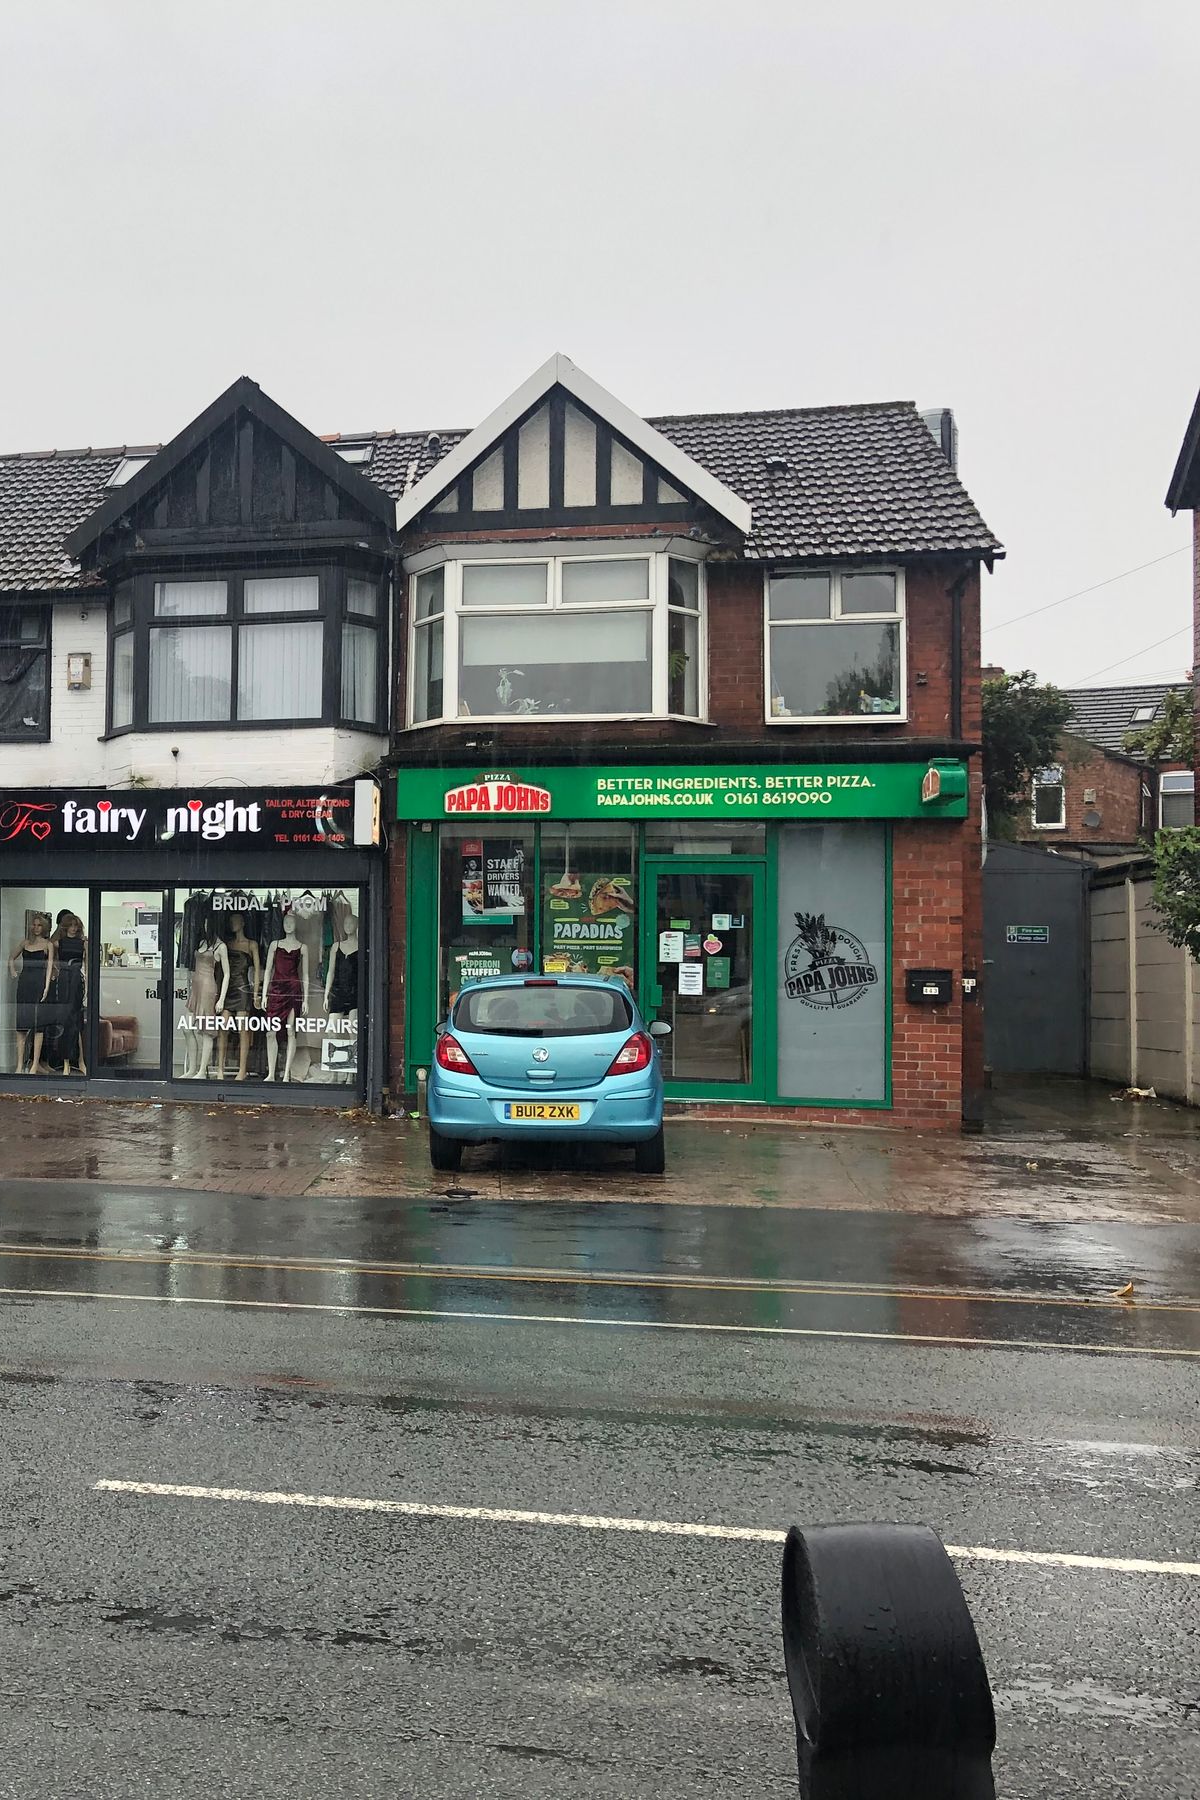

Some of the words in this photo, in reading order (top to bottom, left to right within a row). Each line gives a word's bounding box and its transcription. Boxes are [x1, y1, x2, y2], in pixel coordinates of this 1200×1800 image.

[597, 778, 653, 790] BETTER
[656, 777, 761, 790] INGREDIENTS.
[765, 776, 823, 789] BETTER
[826, 775, 876, 788] PIZZA.
[265, 799, 295, 809] TAILOR,
[296, 799, 350, 808] ALTERATIONS
[447, 786, 491, 811] PAPA
[597, 793, 714, 806] PAPAJOHNS.CO.UK
[724, 792, 758, 805] 0161
[762, 791, 832, 804] 8619090
[61, 800, 147, 841] fairy
[166, 799, 262, 840] night
[281, 811, 289, 819] &
[289, 810, 304, 819] DRY
[306, 810, 332, 819] CLEAN
[274, 834, 289, 842] TEL
[293, 834, 310, 842] 0161
[487, 858, 519, 869] STAFF
[487, 872, 520, 880] DRIVERS
[487, 884, 520, 896] WANTED
[212, 896, 269, 911] BRIDAL
[553, 923, 623, 939] PAPADIAS
[838, 935, 862, 960] DOUGH
[460, 960, 500, 968] PEPPERONI
[460, 968, 500, 976] STUFFED
[788, 971, 826, 995] PAPA
[800, 1000, 829, 1010] QUALITY
[837, 988, 868, 1009] GUARANTEE
[177, 1015, 282, 1032] ALTERATIONS
[516, 1106, 545, 1117] BU12
[549, 1106, 574, 1117] ZXK
